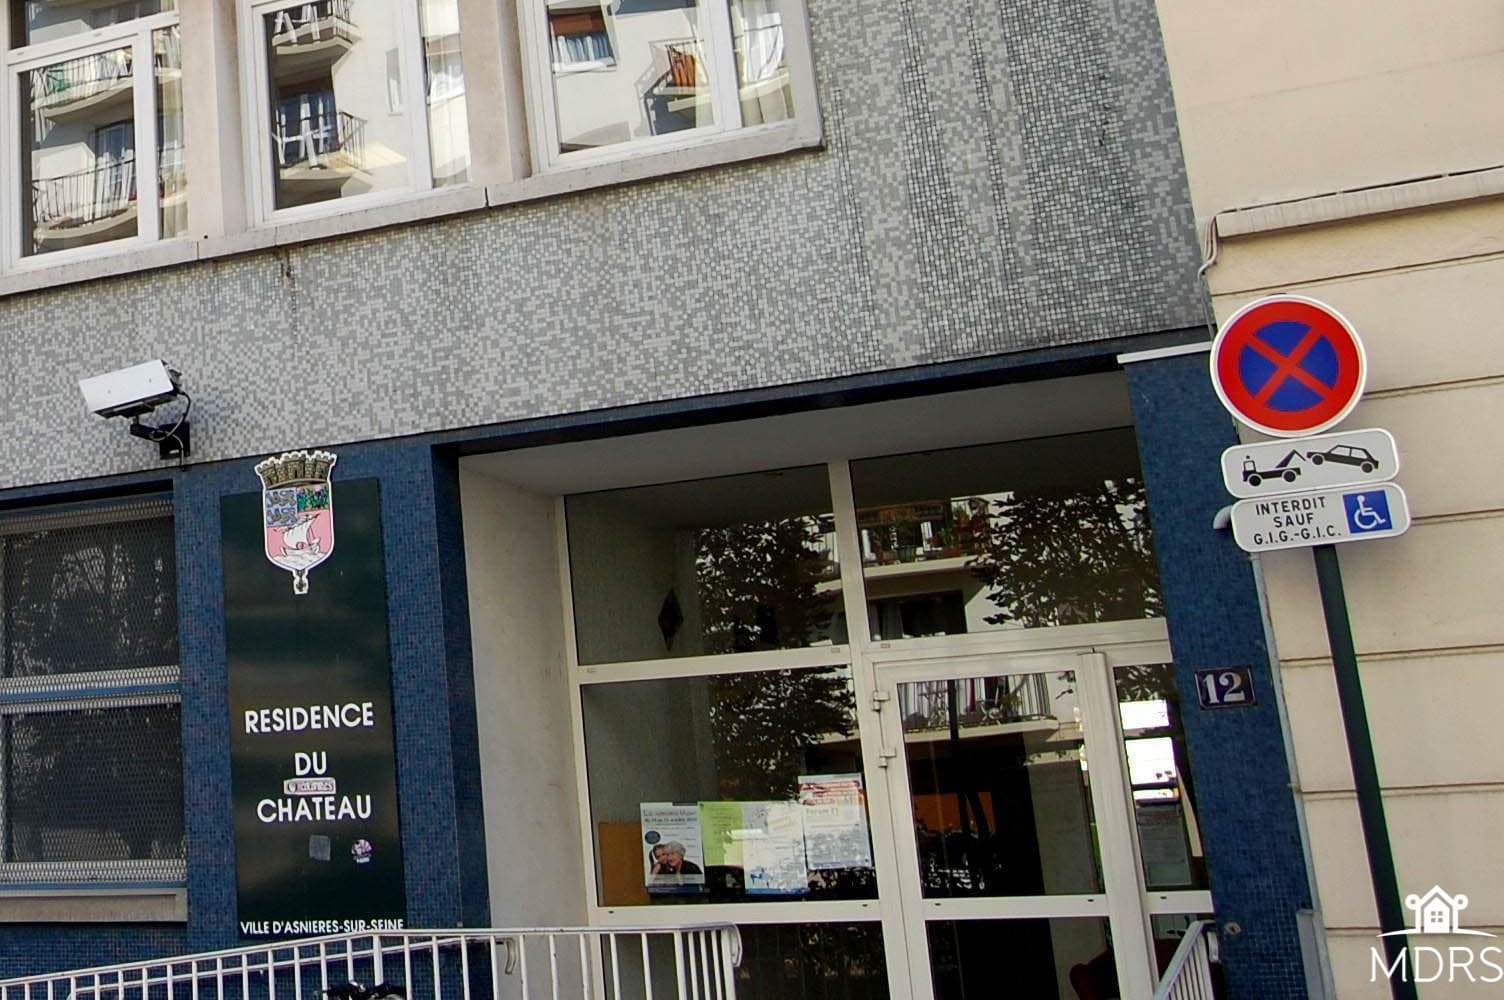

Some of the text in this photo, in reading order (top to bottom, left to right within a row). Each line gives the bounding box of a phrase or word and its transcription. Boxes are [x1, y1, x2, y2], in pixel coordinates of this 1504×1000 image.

[1255, 496, 1327, 516] INTERDIT
[1273, 512, 1315, 528] SAUF
[1253, 525, 1342, 546] G.I.G.-G.I.C.
[1202, 672, 1247, 705] 12
[244, 702, 374, 734] RESIDENCE
[294, 751, 327, 776] DU
[256, 794, 372, 822] CHATEAU
[240, 919, 404, 935] VILLE D'ASNIERES-SUR-SEINE
